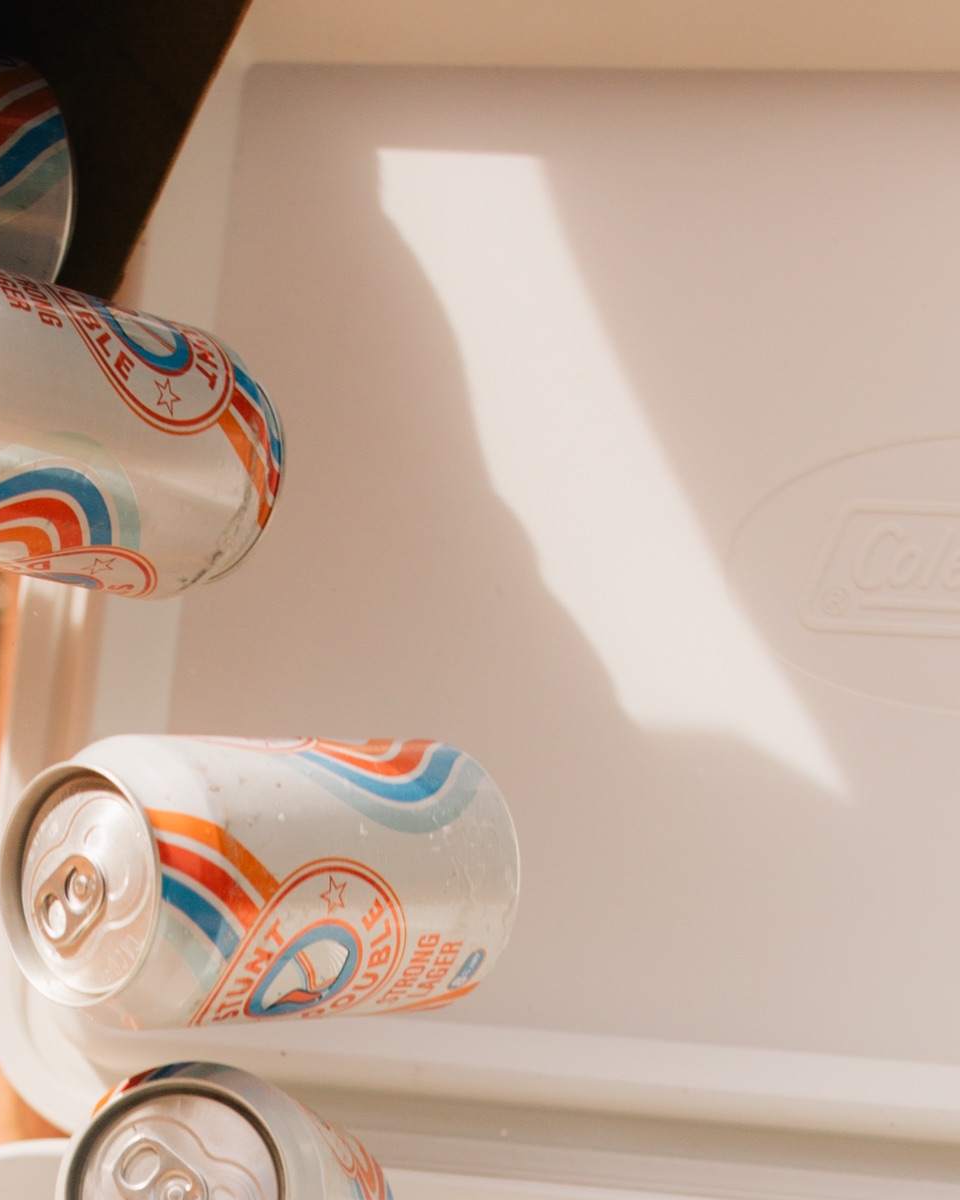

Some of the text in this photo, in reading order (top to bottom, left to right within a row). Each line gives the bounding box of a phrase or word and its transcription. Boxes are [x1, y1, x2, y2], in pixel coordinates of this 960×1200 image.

[58, 289, 135, 381] UBLE
[376, 933, 441, 1005] STRONG
[407, 941, 463, 998] LAGER
